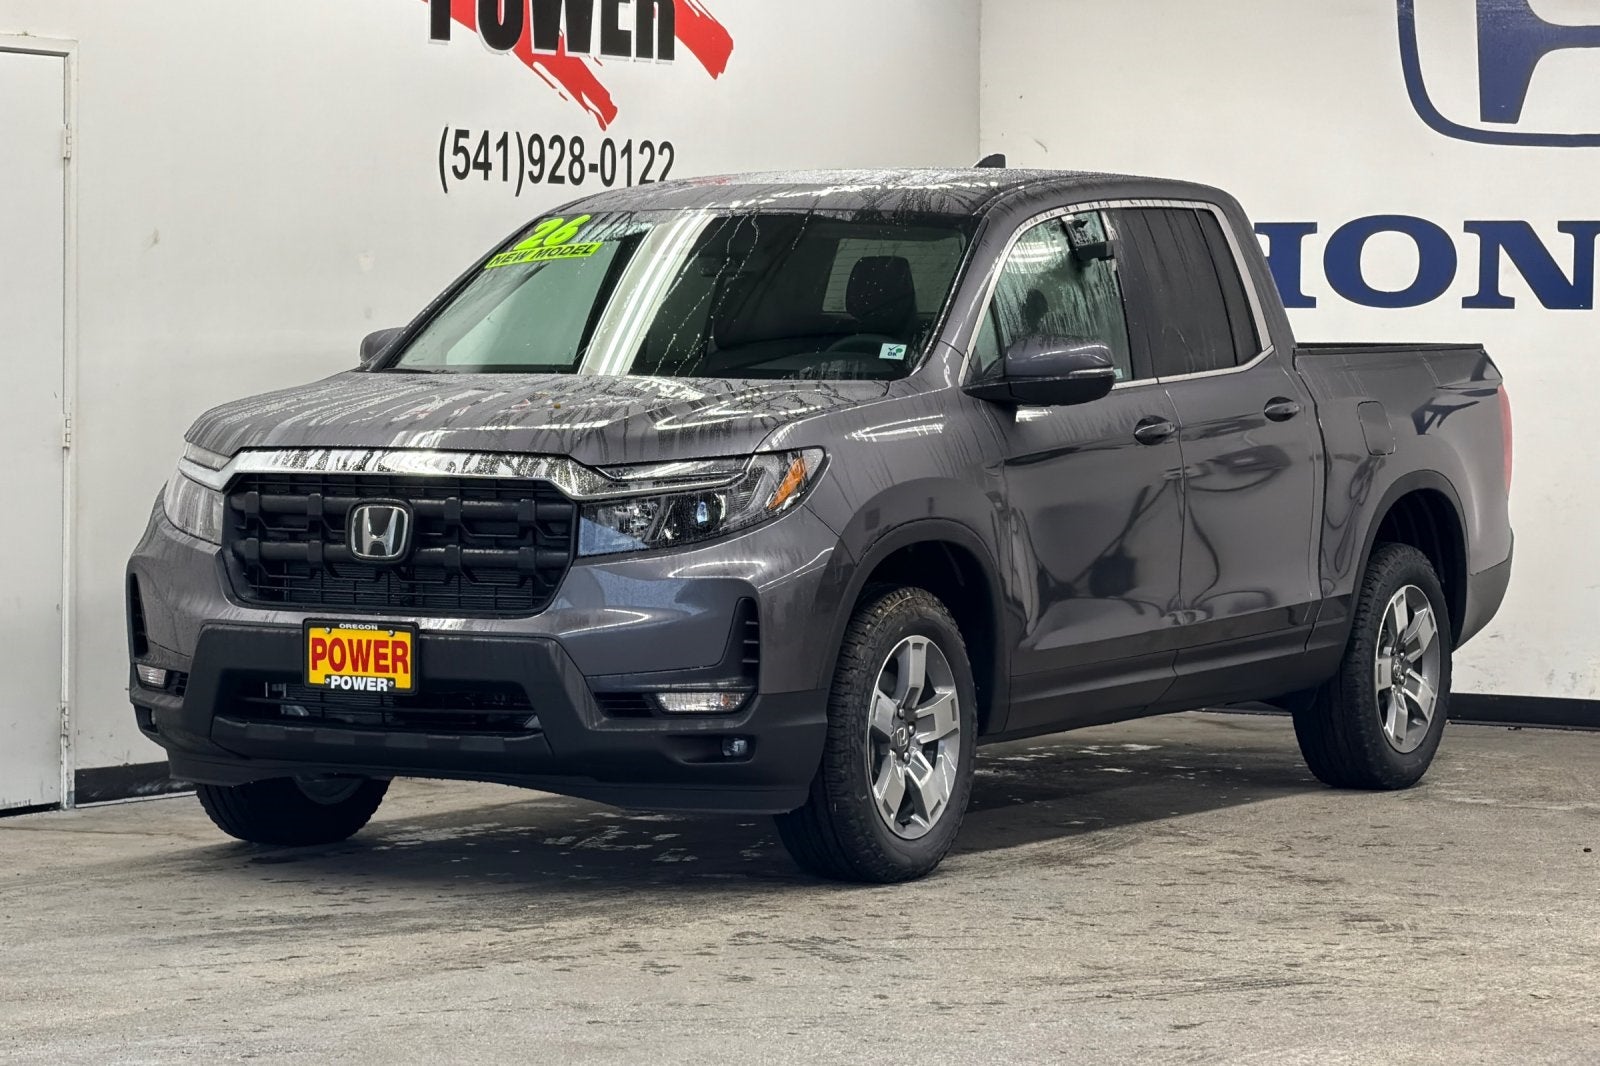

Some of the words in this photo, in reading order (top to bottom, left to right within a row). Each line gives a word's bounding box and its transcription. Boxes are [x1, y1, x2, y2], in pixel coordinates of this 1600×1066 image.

[438, 126, 675, 197] (541)928-0122
[513, 214, 592, 250] 26
[490, 251, 529, 265] NEW
[531, 244, 595, 259] MODEL
[339, 622, 378, 631] OREGON
[311, 637, 410, 675] POWER
[330, 675, 388, 692] POWER
